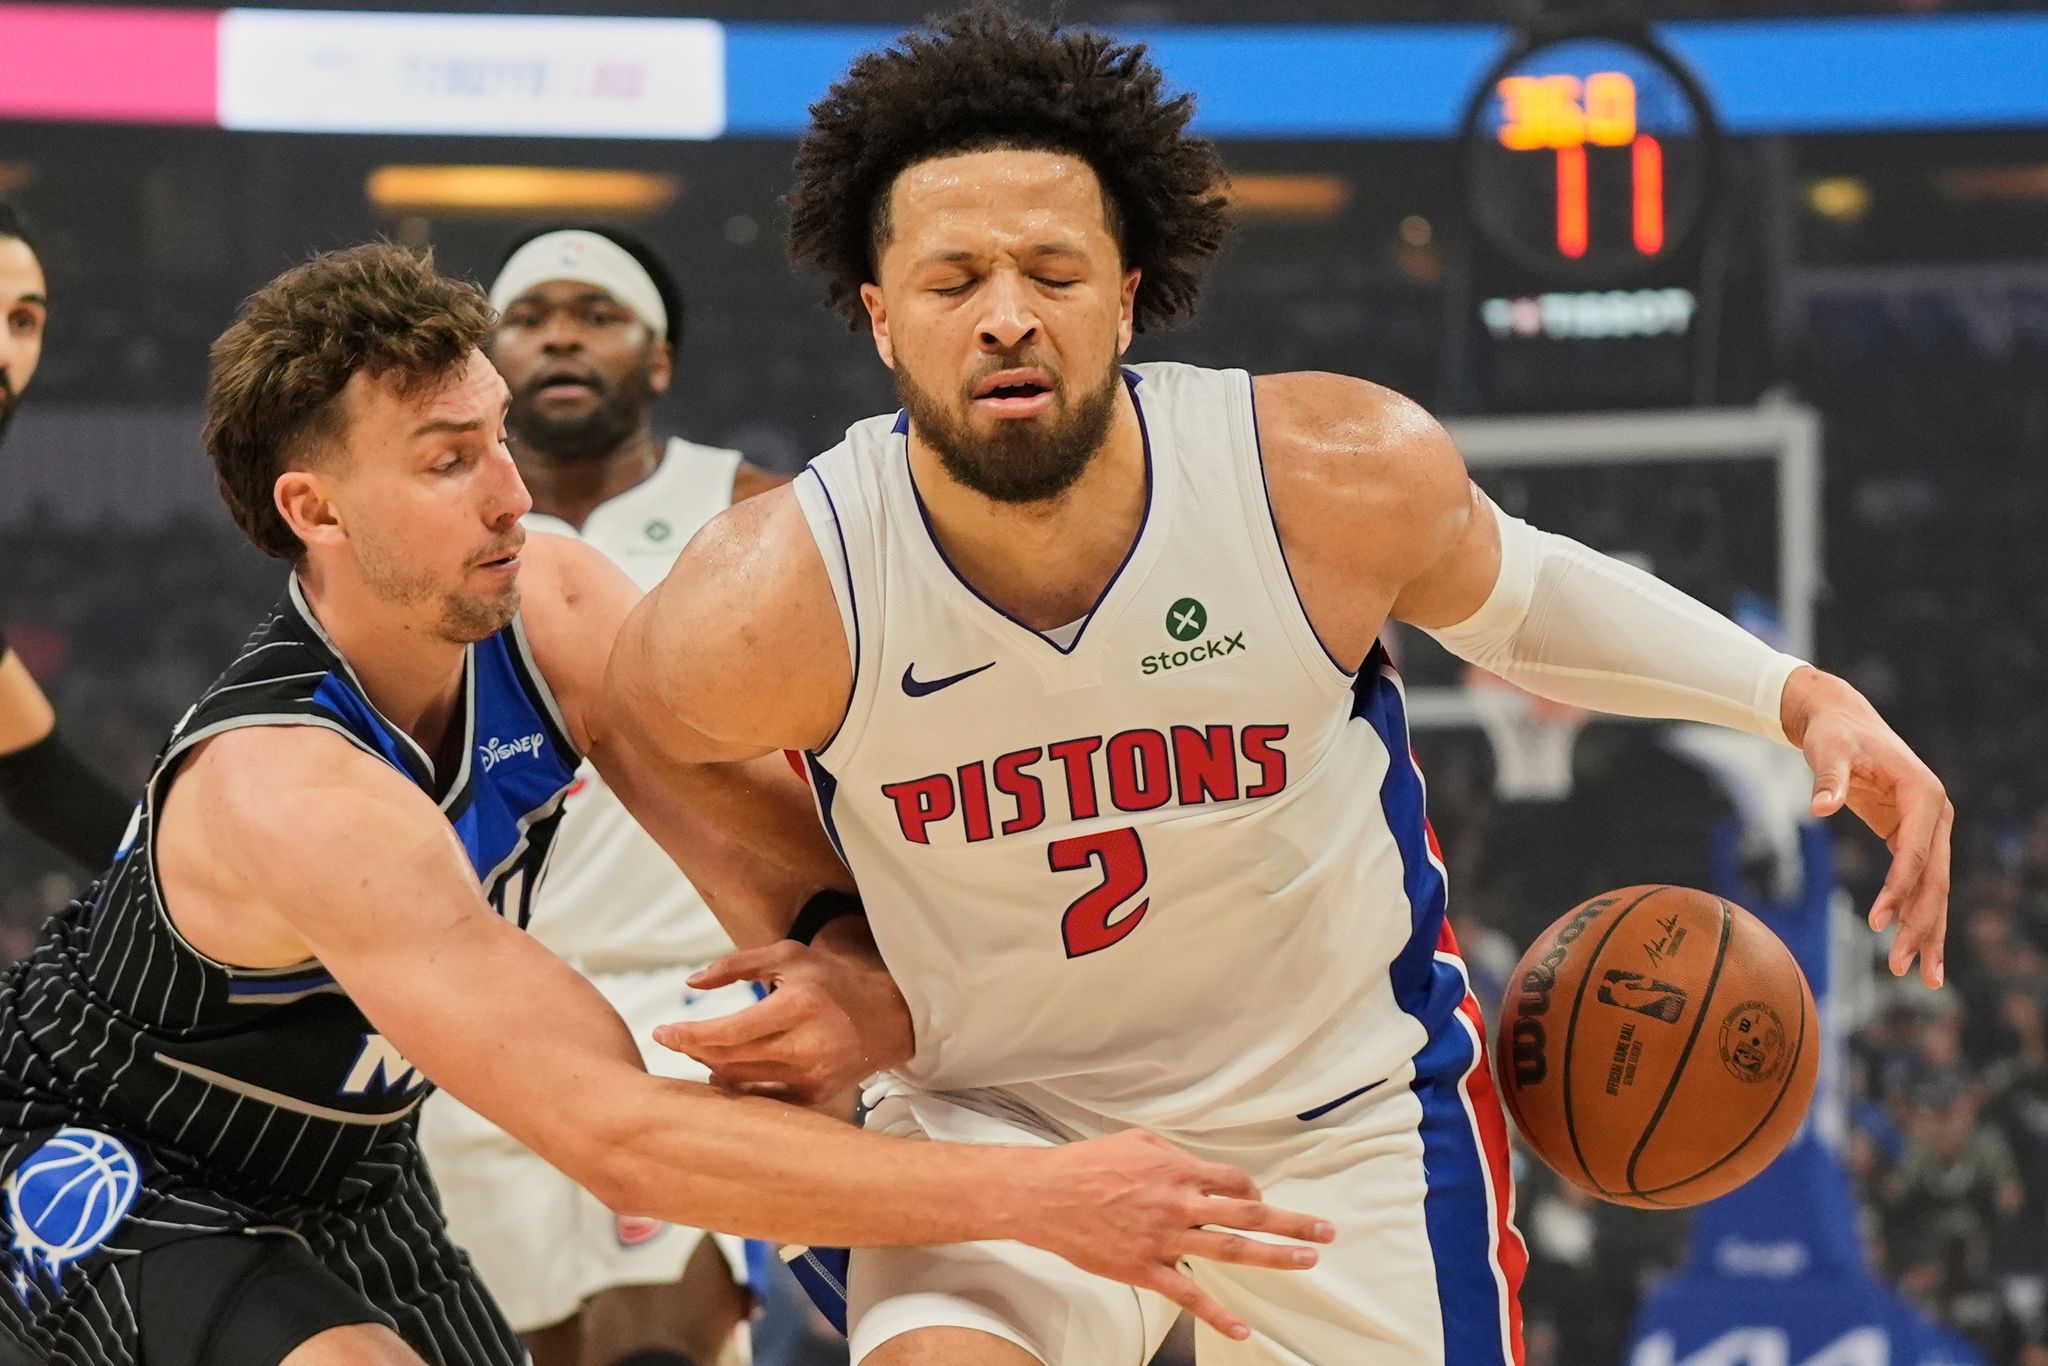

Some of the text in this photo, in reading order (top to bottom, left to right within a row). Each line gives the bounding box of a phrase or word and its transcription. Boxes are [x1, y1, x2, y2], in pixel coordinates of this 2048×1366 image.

[1141, 629, 1246, 677] StockX
[880, 723, 1290, 845] PISTONS
[1047, 826, 1151, 961] 2
[1620, 1022, 1636, 1042] BALL
